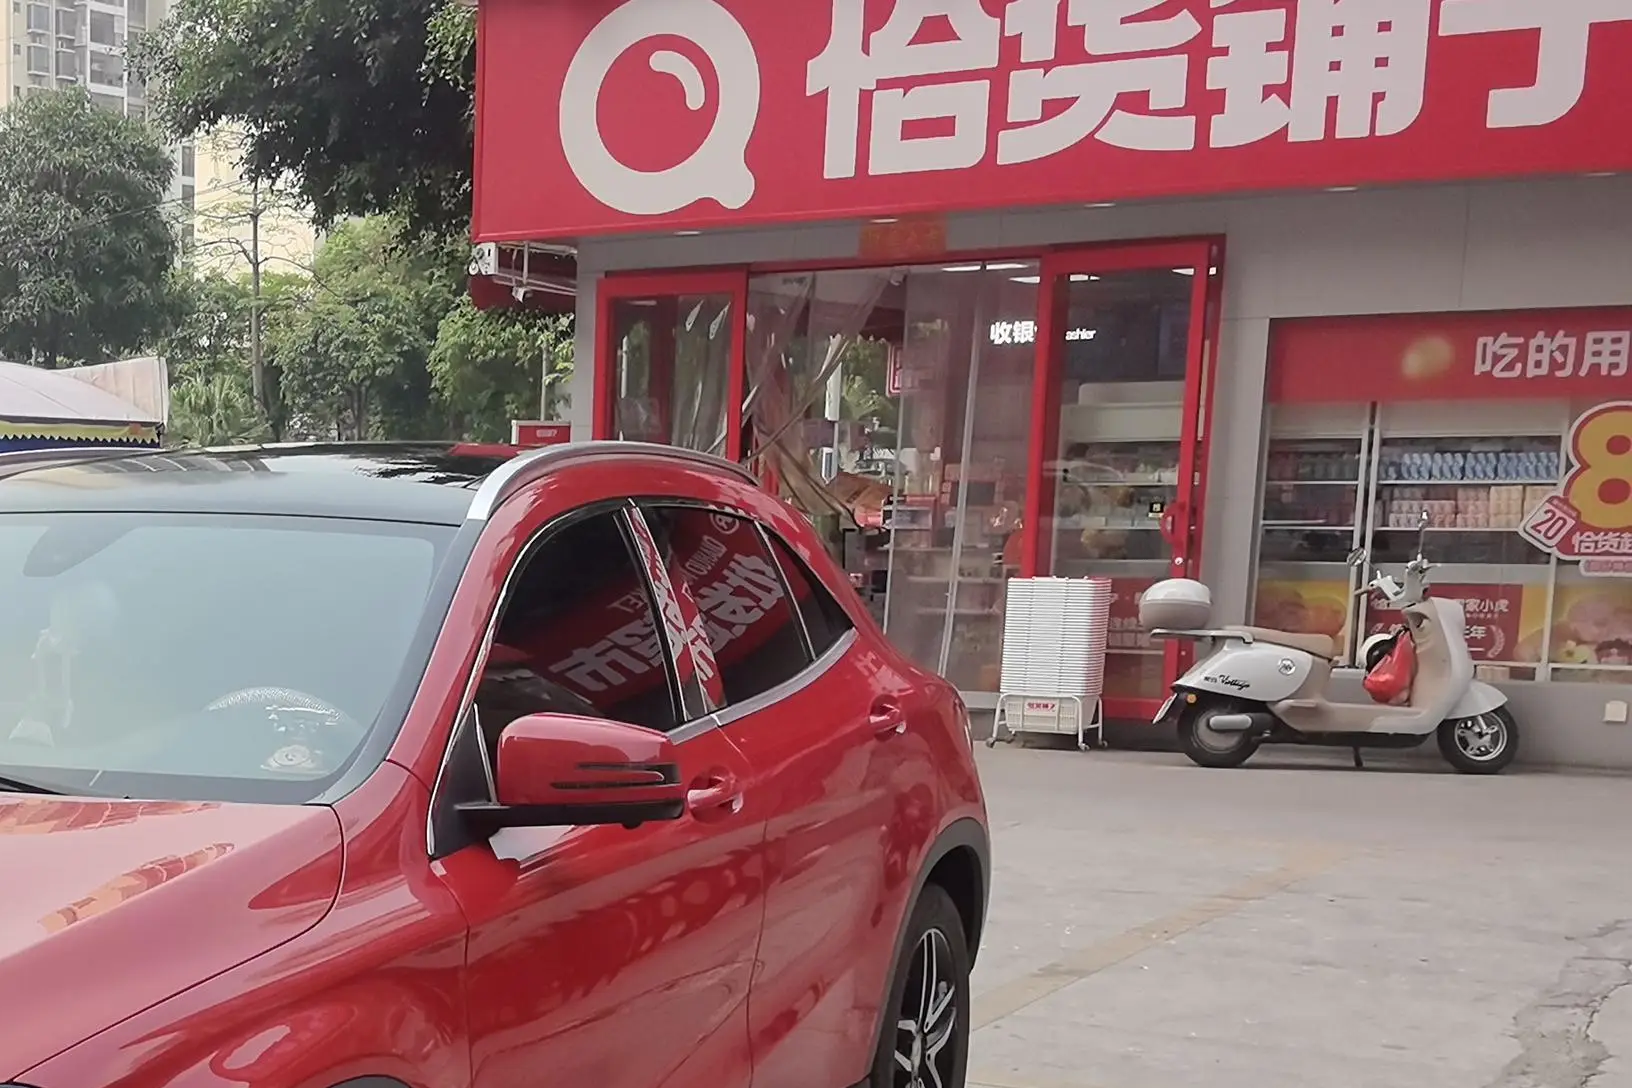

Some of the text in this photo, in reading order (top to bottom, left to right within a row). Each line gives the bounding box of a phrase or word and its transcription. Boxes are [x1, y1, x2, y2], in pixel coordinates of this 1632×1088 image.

[990, 320, 1038, 344] 收银
[1065, 327, 1097, 341] ashier
[1474, 330, 1631, 378] 吃的用
[1531, 509, 1568, 541] 20
[1460, 599, 1509, 612] 家小虎
